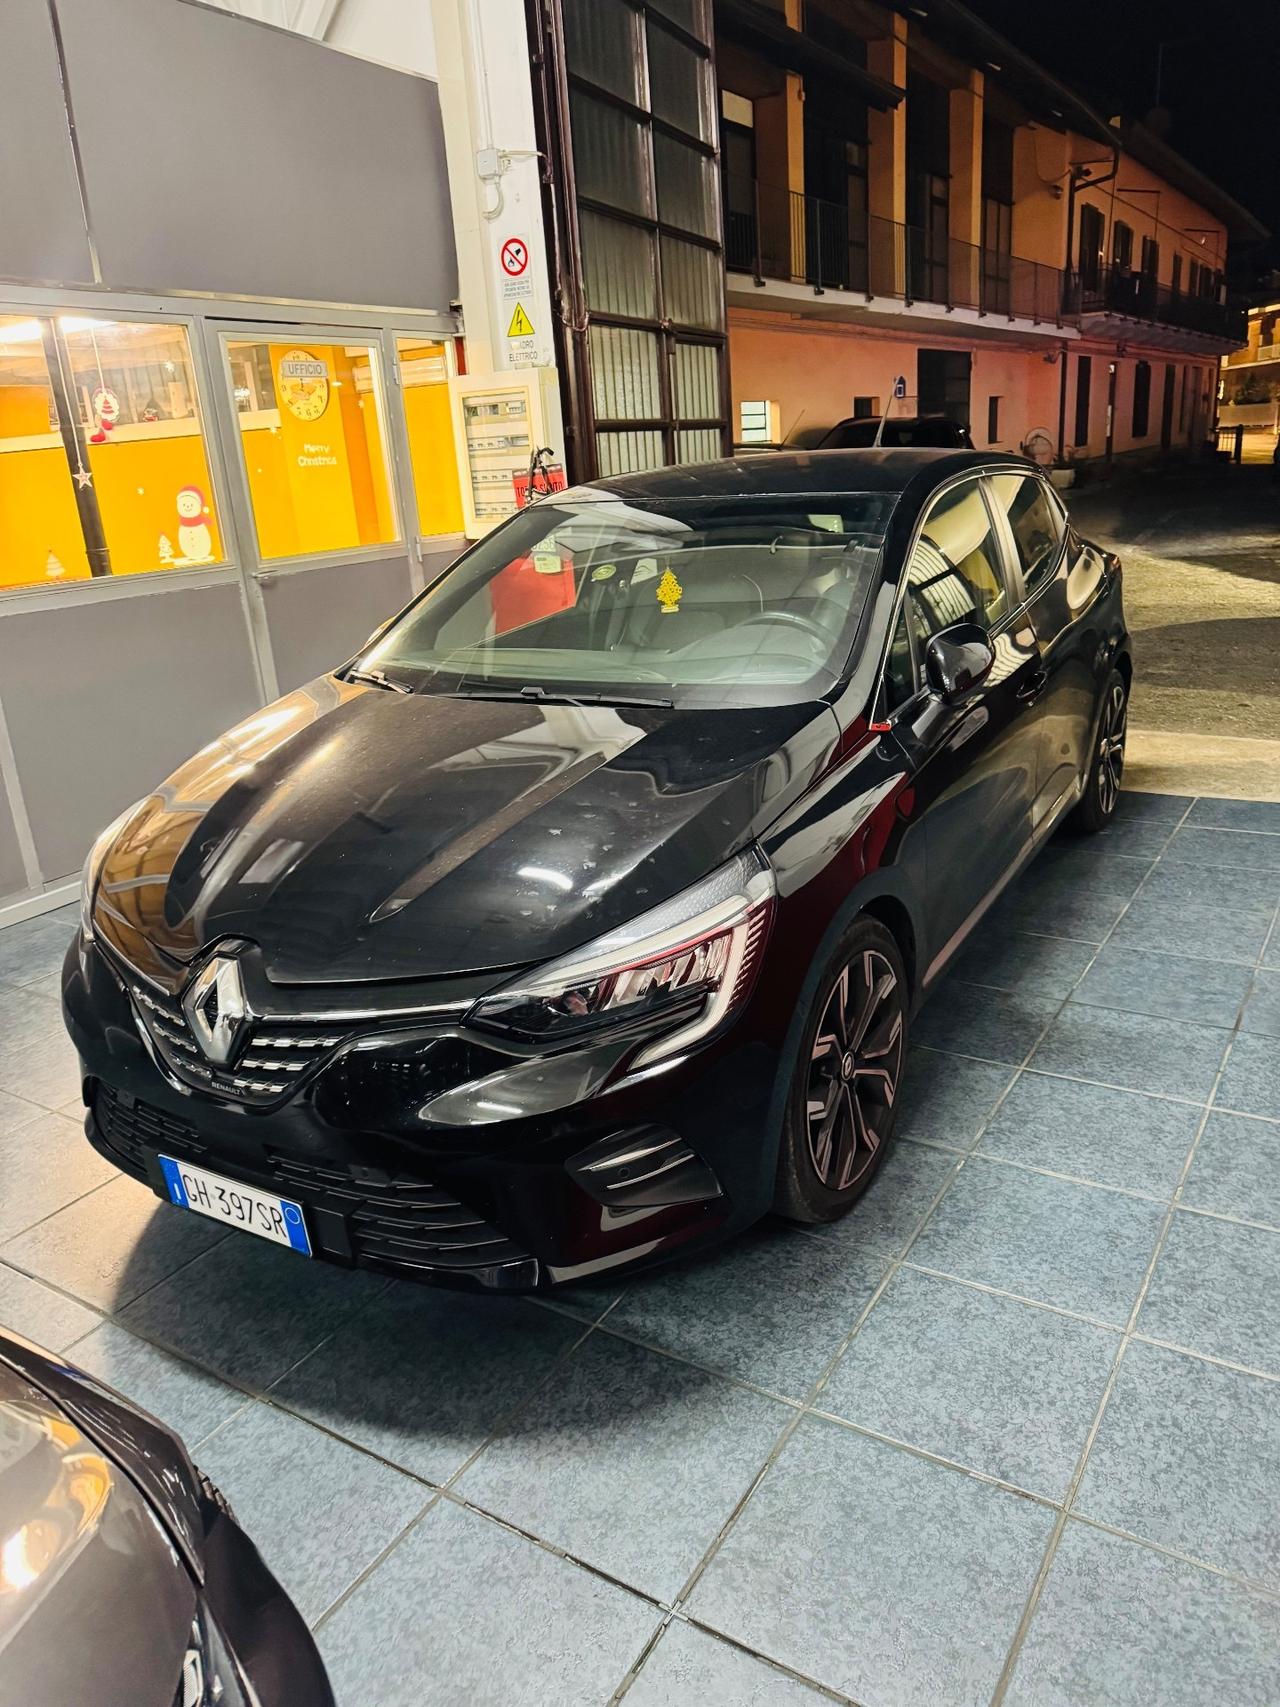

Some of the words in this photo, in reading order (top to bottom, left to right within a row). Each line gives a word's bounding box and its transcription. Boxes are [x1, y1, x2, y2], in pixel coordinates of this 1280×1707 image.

[509, 351, 538, 362] ELETTRICO
[287, 363, 323, 375] UFFICIO
[211, 1081, 241, 1096] RENAULT
